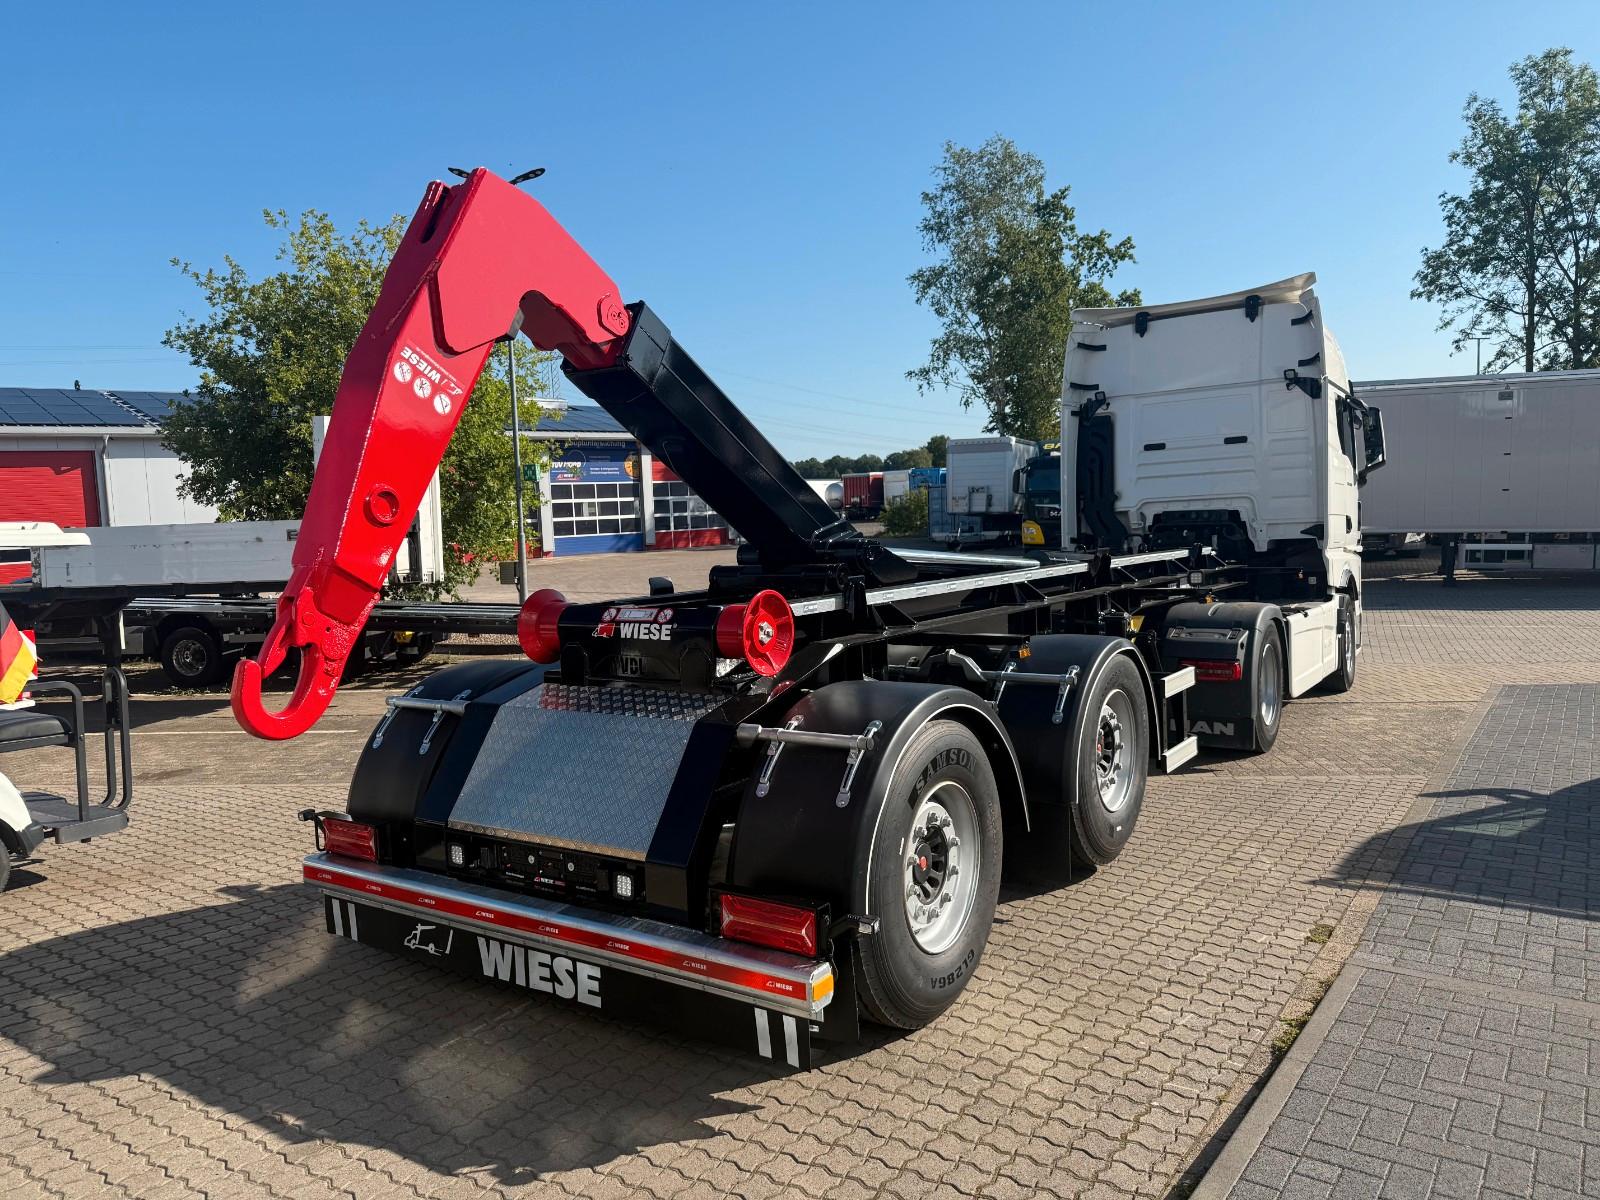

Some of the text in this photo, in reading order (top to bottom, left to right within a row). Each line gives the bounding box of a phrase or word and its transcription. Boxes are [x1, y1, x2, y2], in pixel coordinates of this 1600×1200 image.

[400, 346, 441, 384] WIESE
[620, 622, 672, 641] WIESE
[915, 748, 977, 794] SAMSON
[477, 935, 602, 1009] WIESE
